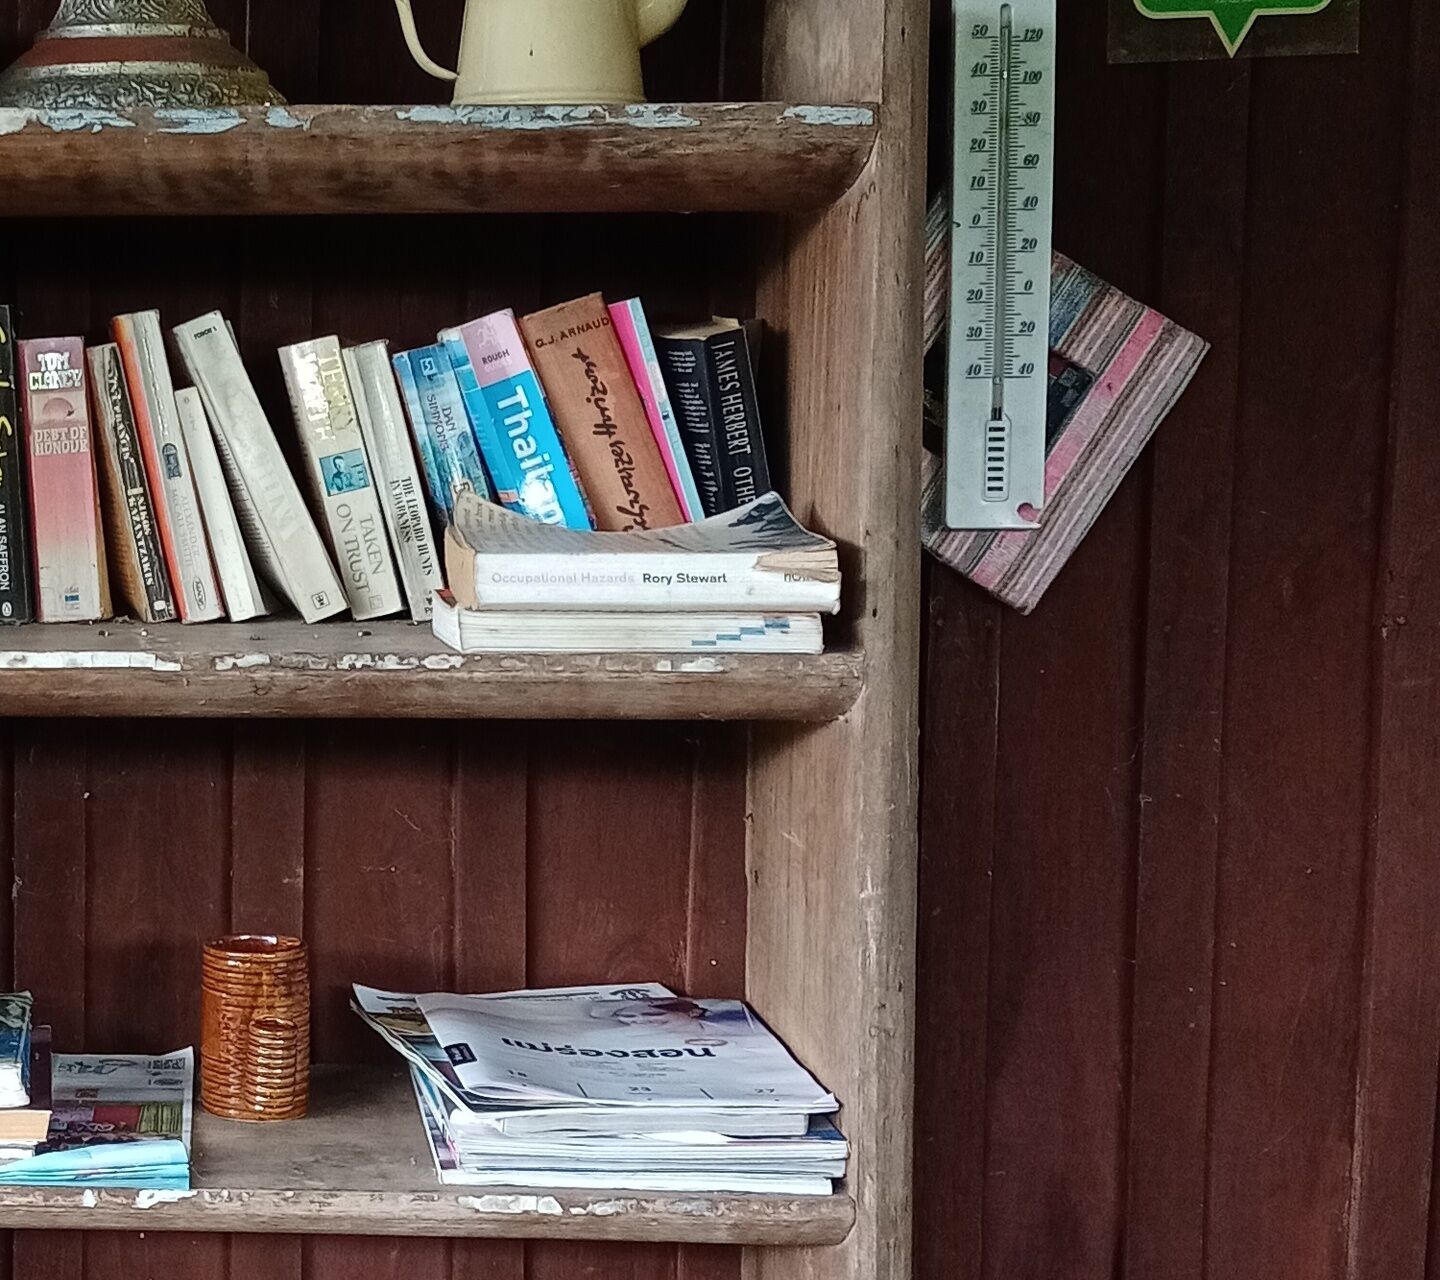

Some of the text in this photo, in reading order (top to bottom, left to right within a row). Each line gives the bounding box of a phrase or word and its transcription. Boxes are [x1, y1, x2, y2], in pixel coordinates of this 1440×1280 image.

[972, 24, 988, 37] 50
[1022, 28, 1043, 41] 120
[971, 62, 987, 75] 40
[1022, 70, 1042, 83] 100
[971, 100, 986, 113] 30
[1025, 112, 1040, 125] 80
[970, 138, 986, 151] 20
[1024, 154, 1040, 167] 60
[970, 176, 986, 189] 10
[1022, 196, 1038, 208] 40
[972, 214, 981, 226] 0
[1021, 238, 1037, 250] 20
[968, 251, 984, 264] 10
[1024, 280, 1033, 292] 0
[967, 289, 983, 302] 20
[560, 317, 610, 340] ARNAUD
[966, 326, 982, 340] 30
[1020, 322, 1036, 334] 20
[37, 352, 69, 372] TOM
[481, 348, 510, 366] ROUGH
[966, 364, 982, 377] 40
[1018, 364, 1034, 376] 40
[29, 369, 82, 390] CLANCY
[426, 393, 449, 451] SIMMONS
[441, 406, 457, 433] DAN
[710, 339, 757, 506] JAMES HERBERT OTHE
[35, 427, 87, 442] DEBT OF
[35, 439, 88, 456] HONOUR
[497, 384, 568, 528] Thailn
[136, 495, 152, 536] NIKOS
[392, 492, 413, 543] DARKNESS
[400, 476, 434, 577] THE LEOPARD HUNTS
[335, 501, 370, 592] ON TRUST
[357, 513, 386, 575] TAKEN
[492, 572, 727, 586] Occupational Hazards Rory Stewart
